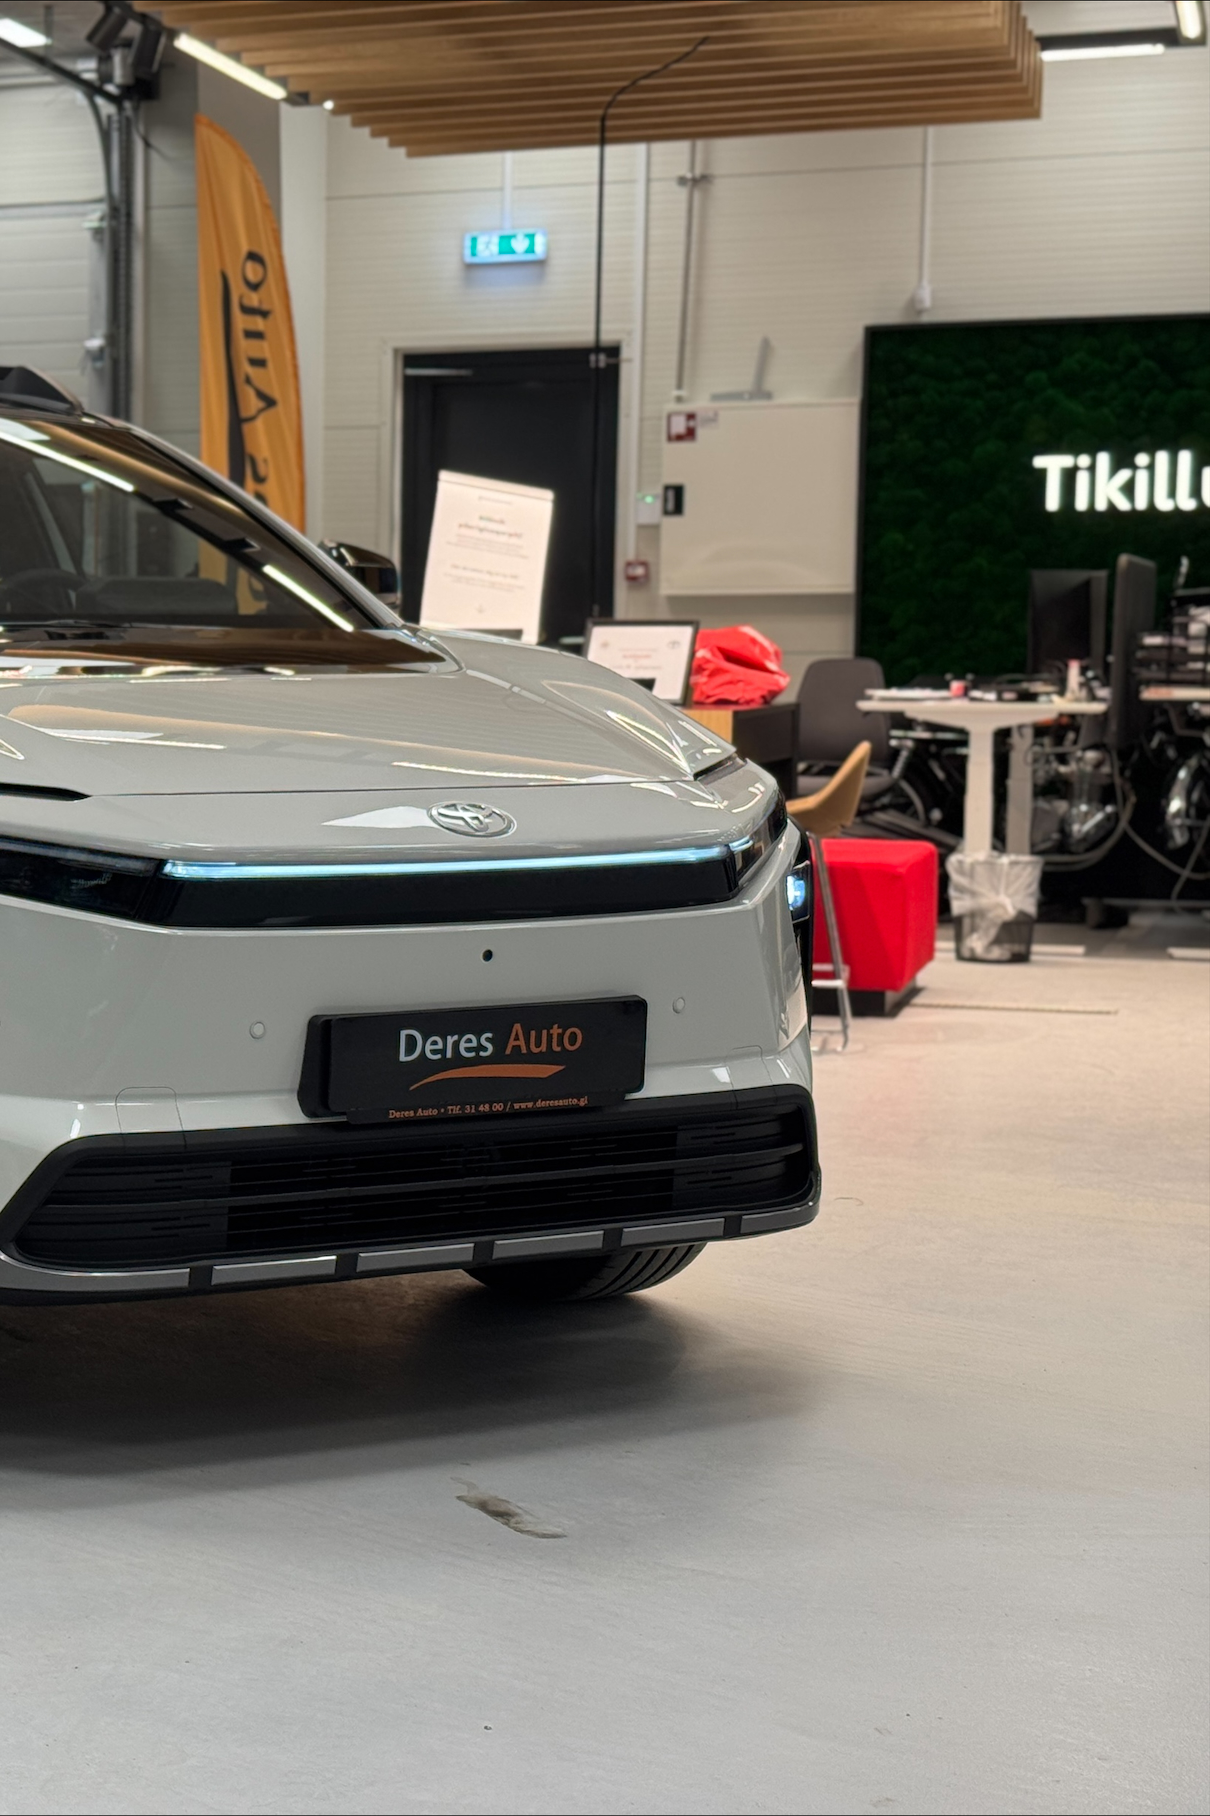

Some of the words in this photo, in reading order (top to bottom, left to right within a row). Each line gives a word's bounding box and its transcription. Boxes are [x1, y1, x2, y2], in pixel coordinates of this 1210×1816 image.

[1032, 449, 1210, 513] Tikill
[399, 1028, 494, 1062] Deres
[504, 1022, 583, 1055] Auto
[388, 1109, 415, 1119] Deres
[416, 1107, 438, 1117] Auto
[447, 1105, 462, 1115] Tlf.
[464, 1104, 476, 1114] 31
[478, 1103, 490, 1113] 48
[492, 1102, 504, 1112] 00
